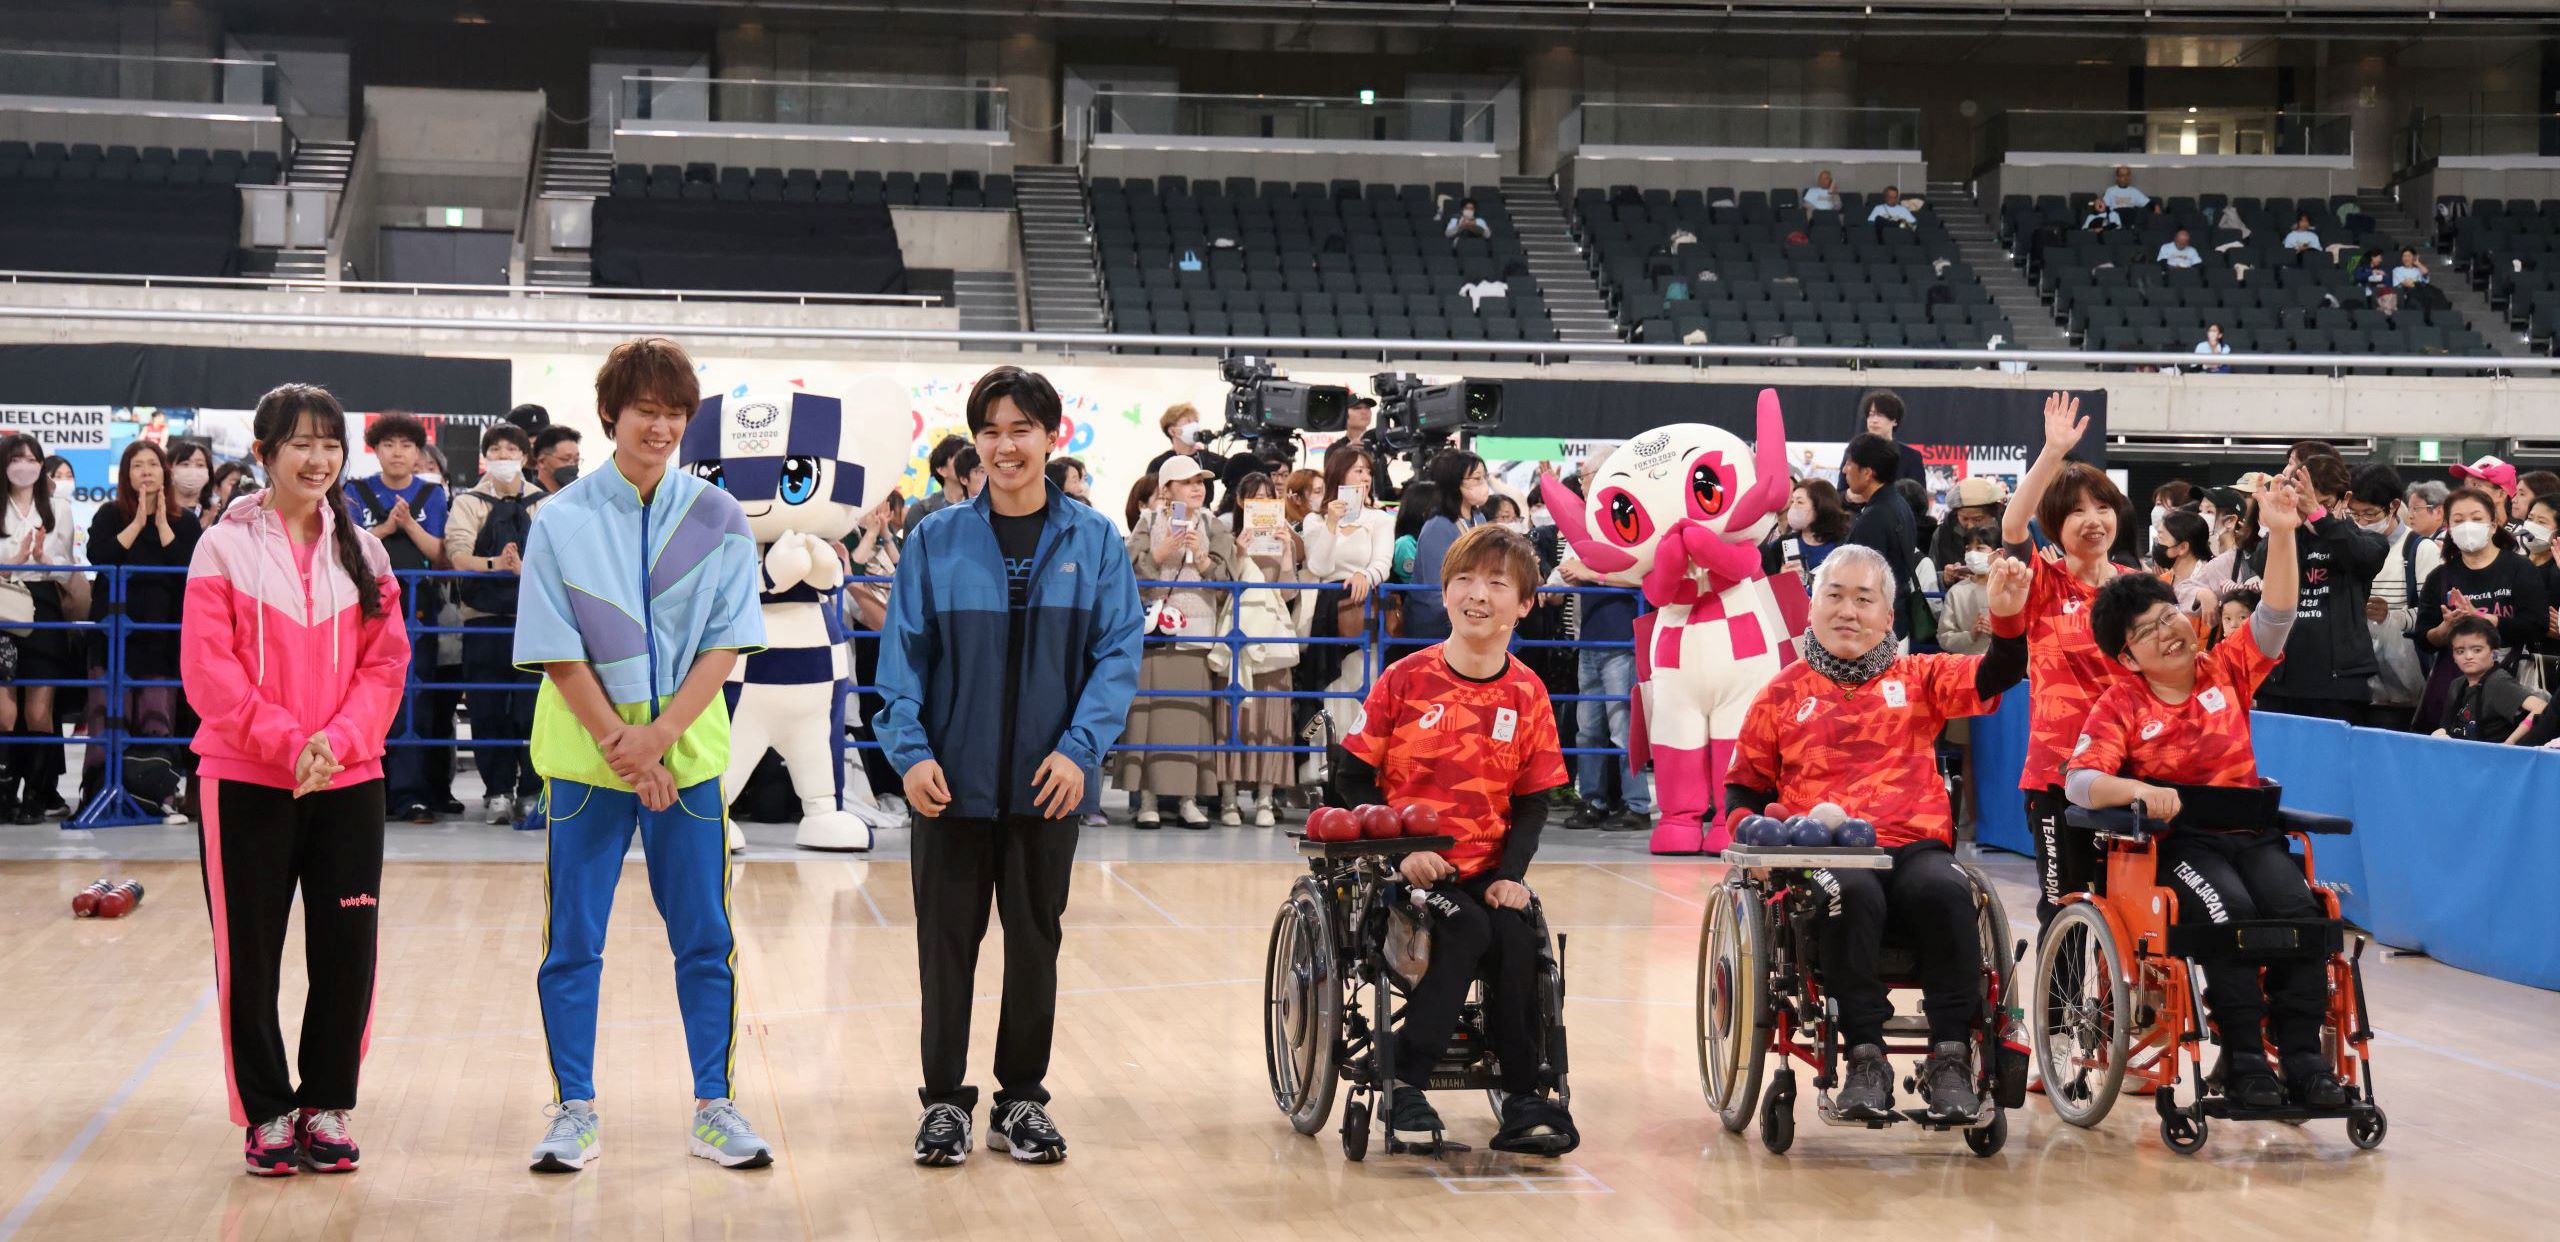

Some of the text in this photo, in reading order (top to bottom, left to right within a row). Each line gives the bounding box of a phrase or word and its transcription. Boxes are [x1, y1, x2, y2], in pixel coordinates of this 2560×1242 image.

[31, 430, 104, 443] TENNIS
[732, 432, 758, 440] TOKYO
[1634, 458, 1657, 470] TOKYO
[1659, 451, 1677, 461] 2020
[1922, 445, 2027, 461] SWIMMING
[2042, 815, 2061, 905] TEAM JAPAN
[2173, 860, 2229, 925] TEAM JAPAN
[1430, 1078, 1466, 1089] YAMAHA
